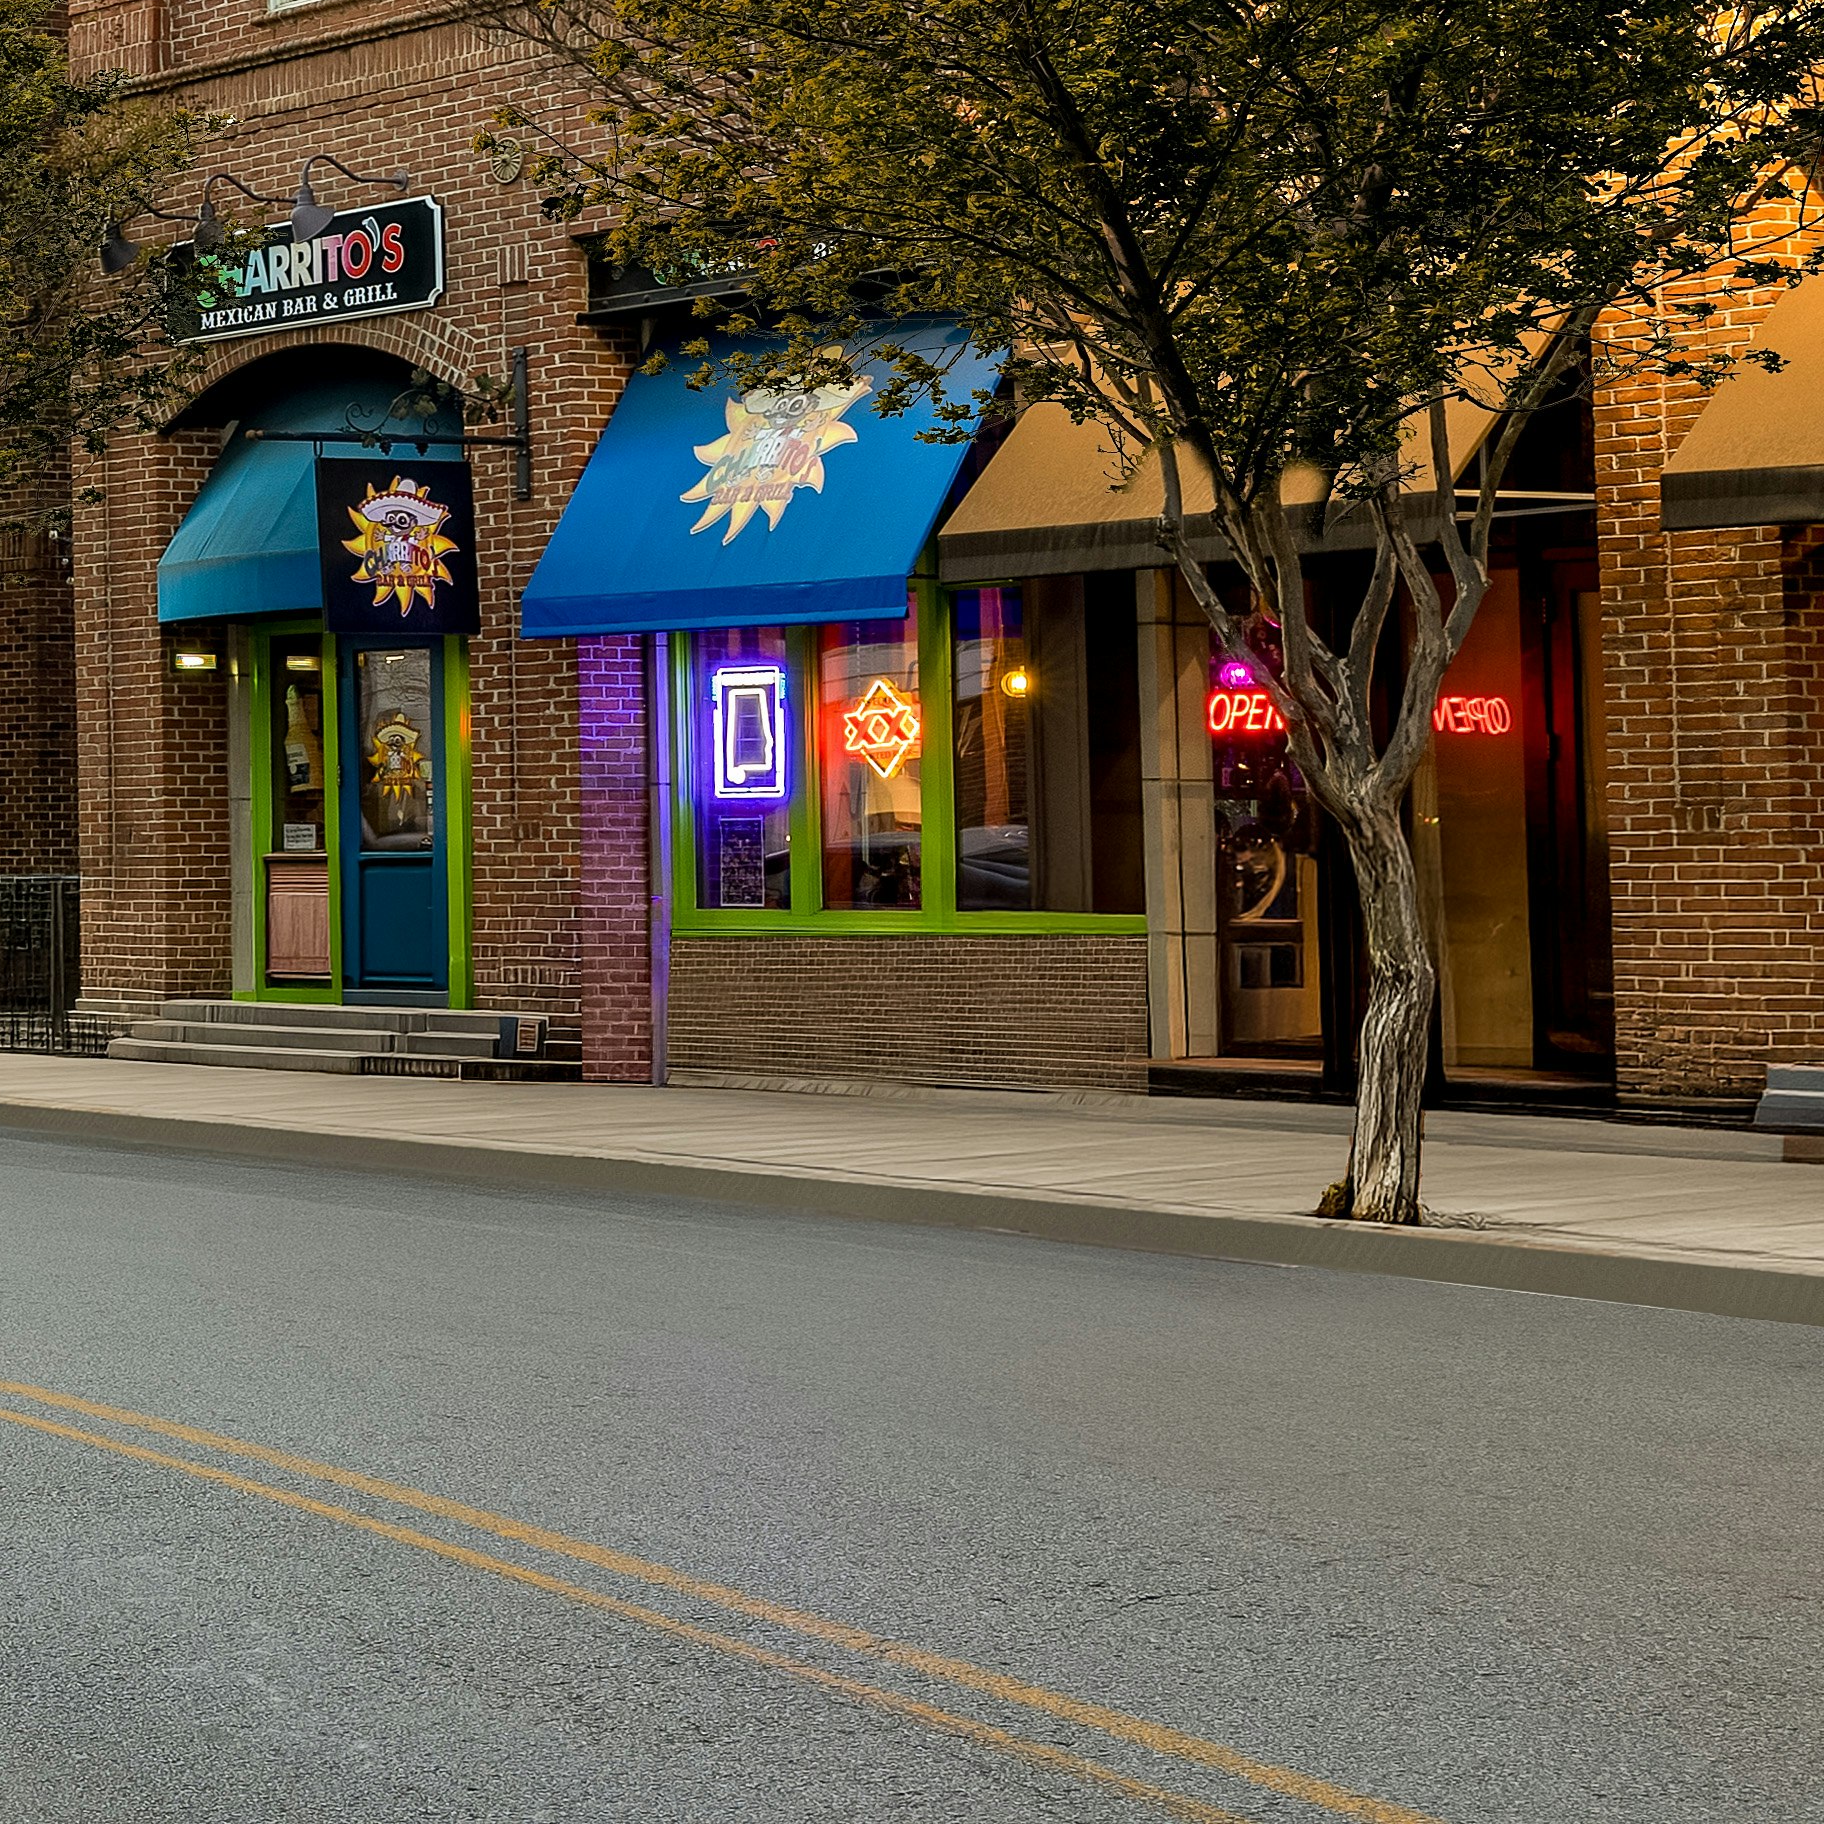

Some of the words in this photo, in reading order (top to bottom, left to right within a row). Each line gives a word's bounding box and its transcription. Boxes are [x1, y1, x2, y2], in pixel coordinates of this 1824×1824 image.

[200, 301, 277, 331] MEXICAN
[282, 295, 318, 318] BAR
[322, 292, 339, 311] &
[343, 282, 398, 307] GRILL
